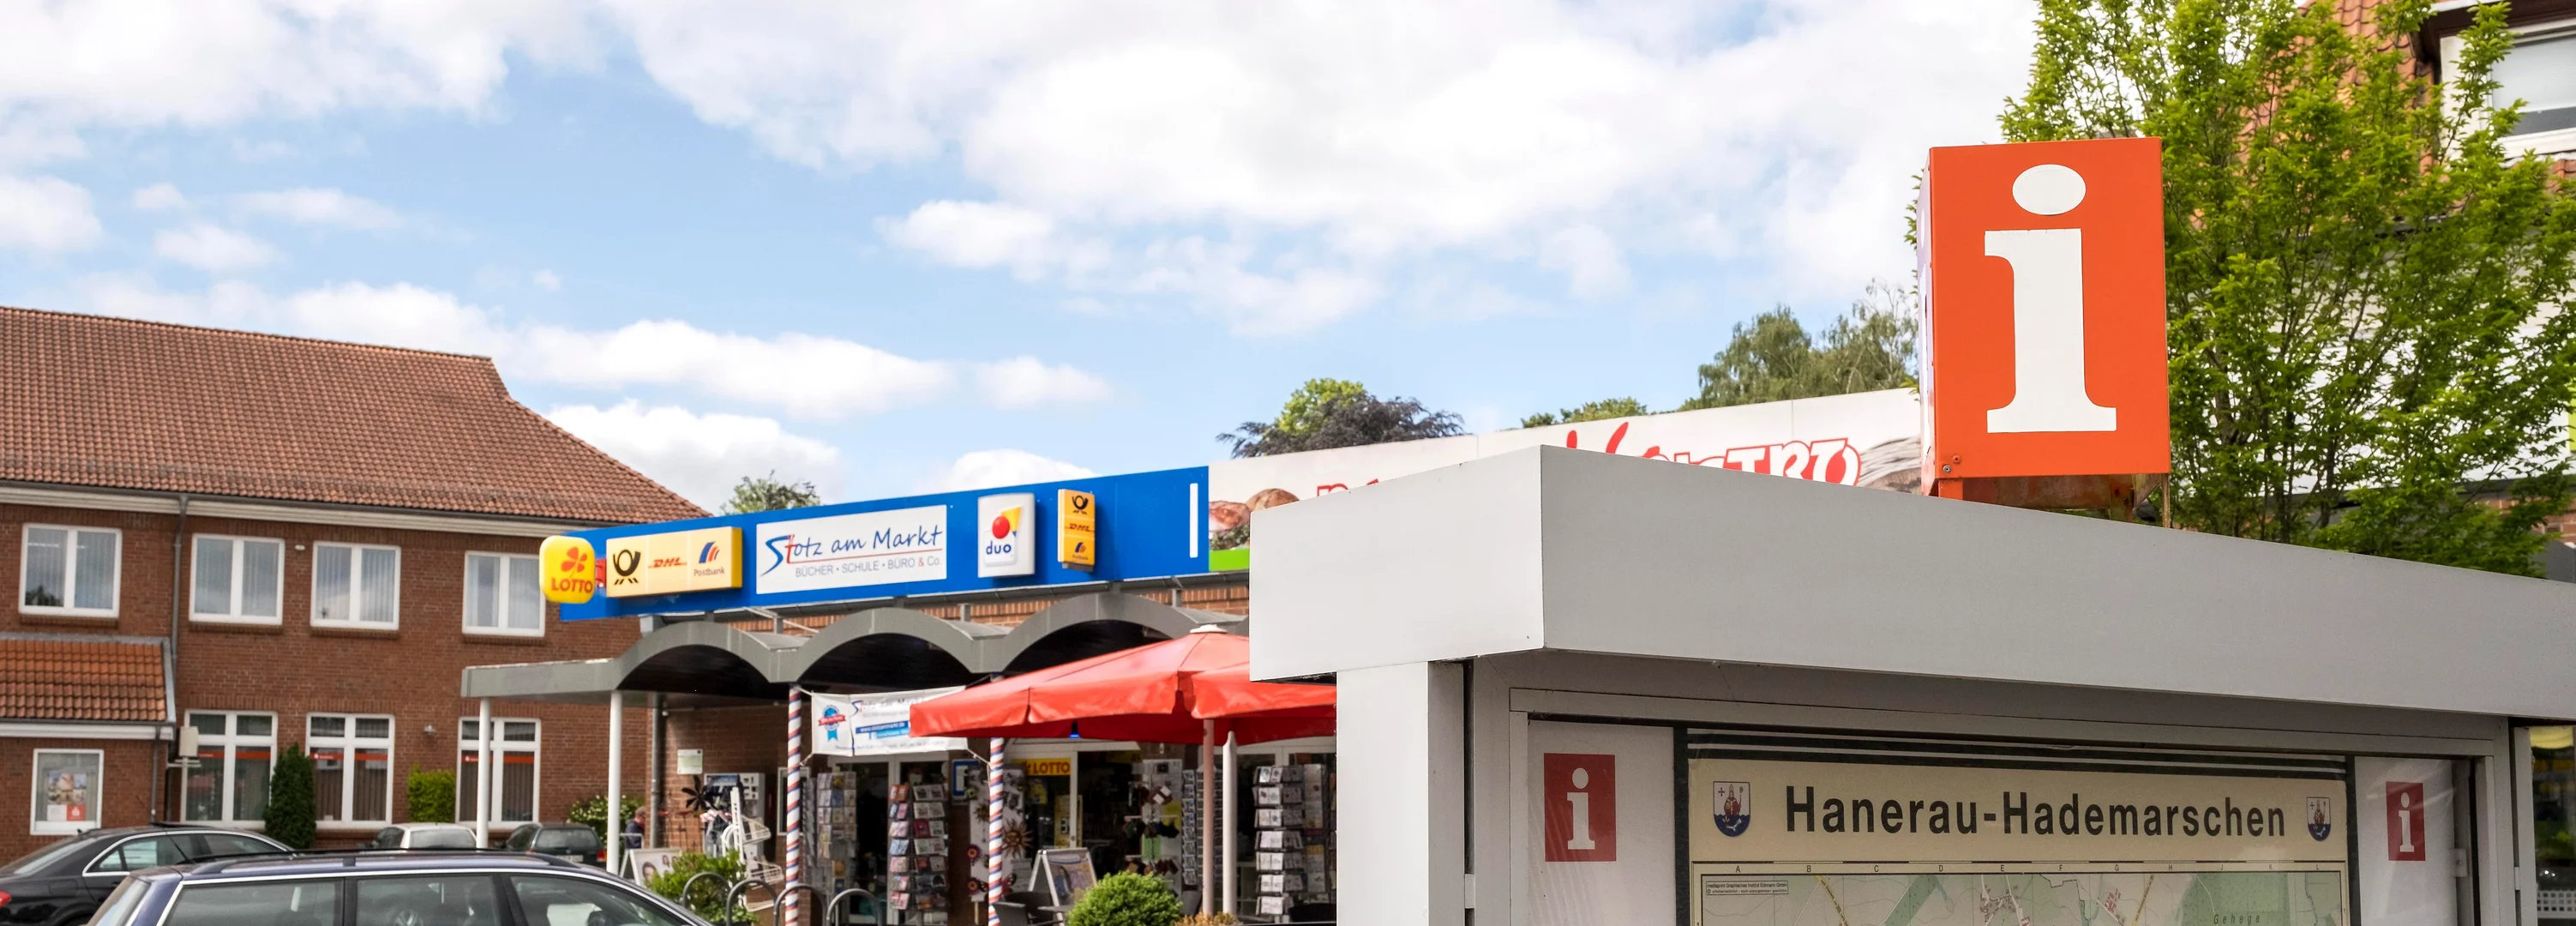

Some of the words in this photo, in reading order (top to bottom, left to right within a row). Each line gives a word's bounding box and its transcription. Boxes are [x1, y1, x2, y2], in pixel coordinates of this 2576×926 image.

[1984, 164, 2117, 434] i
[760, 533, 823, 578] Stotz
[831, 536, 866, 553] am
[873, 524, 943, 550] Markt
[986, 541, 1012, 556] duo
[653, 558, 682, 568] DHL
[796, 563, 834, 579] BÜCHER
[841, 559, 880, 574] SCHULE
[887, 556, 916, 569] BÜRO
[918, 556, 925, 568] &
[694, 568, 725, 577] Postbank
[551, 577, 593, 593] LOTTO
[1033, 761, 1071, 774] LOTTO
[1786, 785, 2285, 836] Hanerau-Hademarschen
[1735, 864, 1741, 873] A
[1806, 864, 1812, 873] B
[1874, 864, 1879, 873] C
[1938, 864, 1944, 873] D
[2114, 863, 2119, 873] G
[2213, 914, 2260, 925] Gehege
